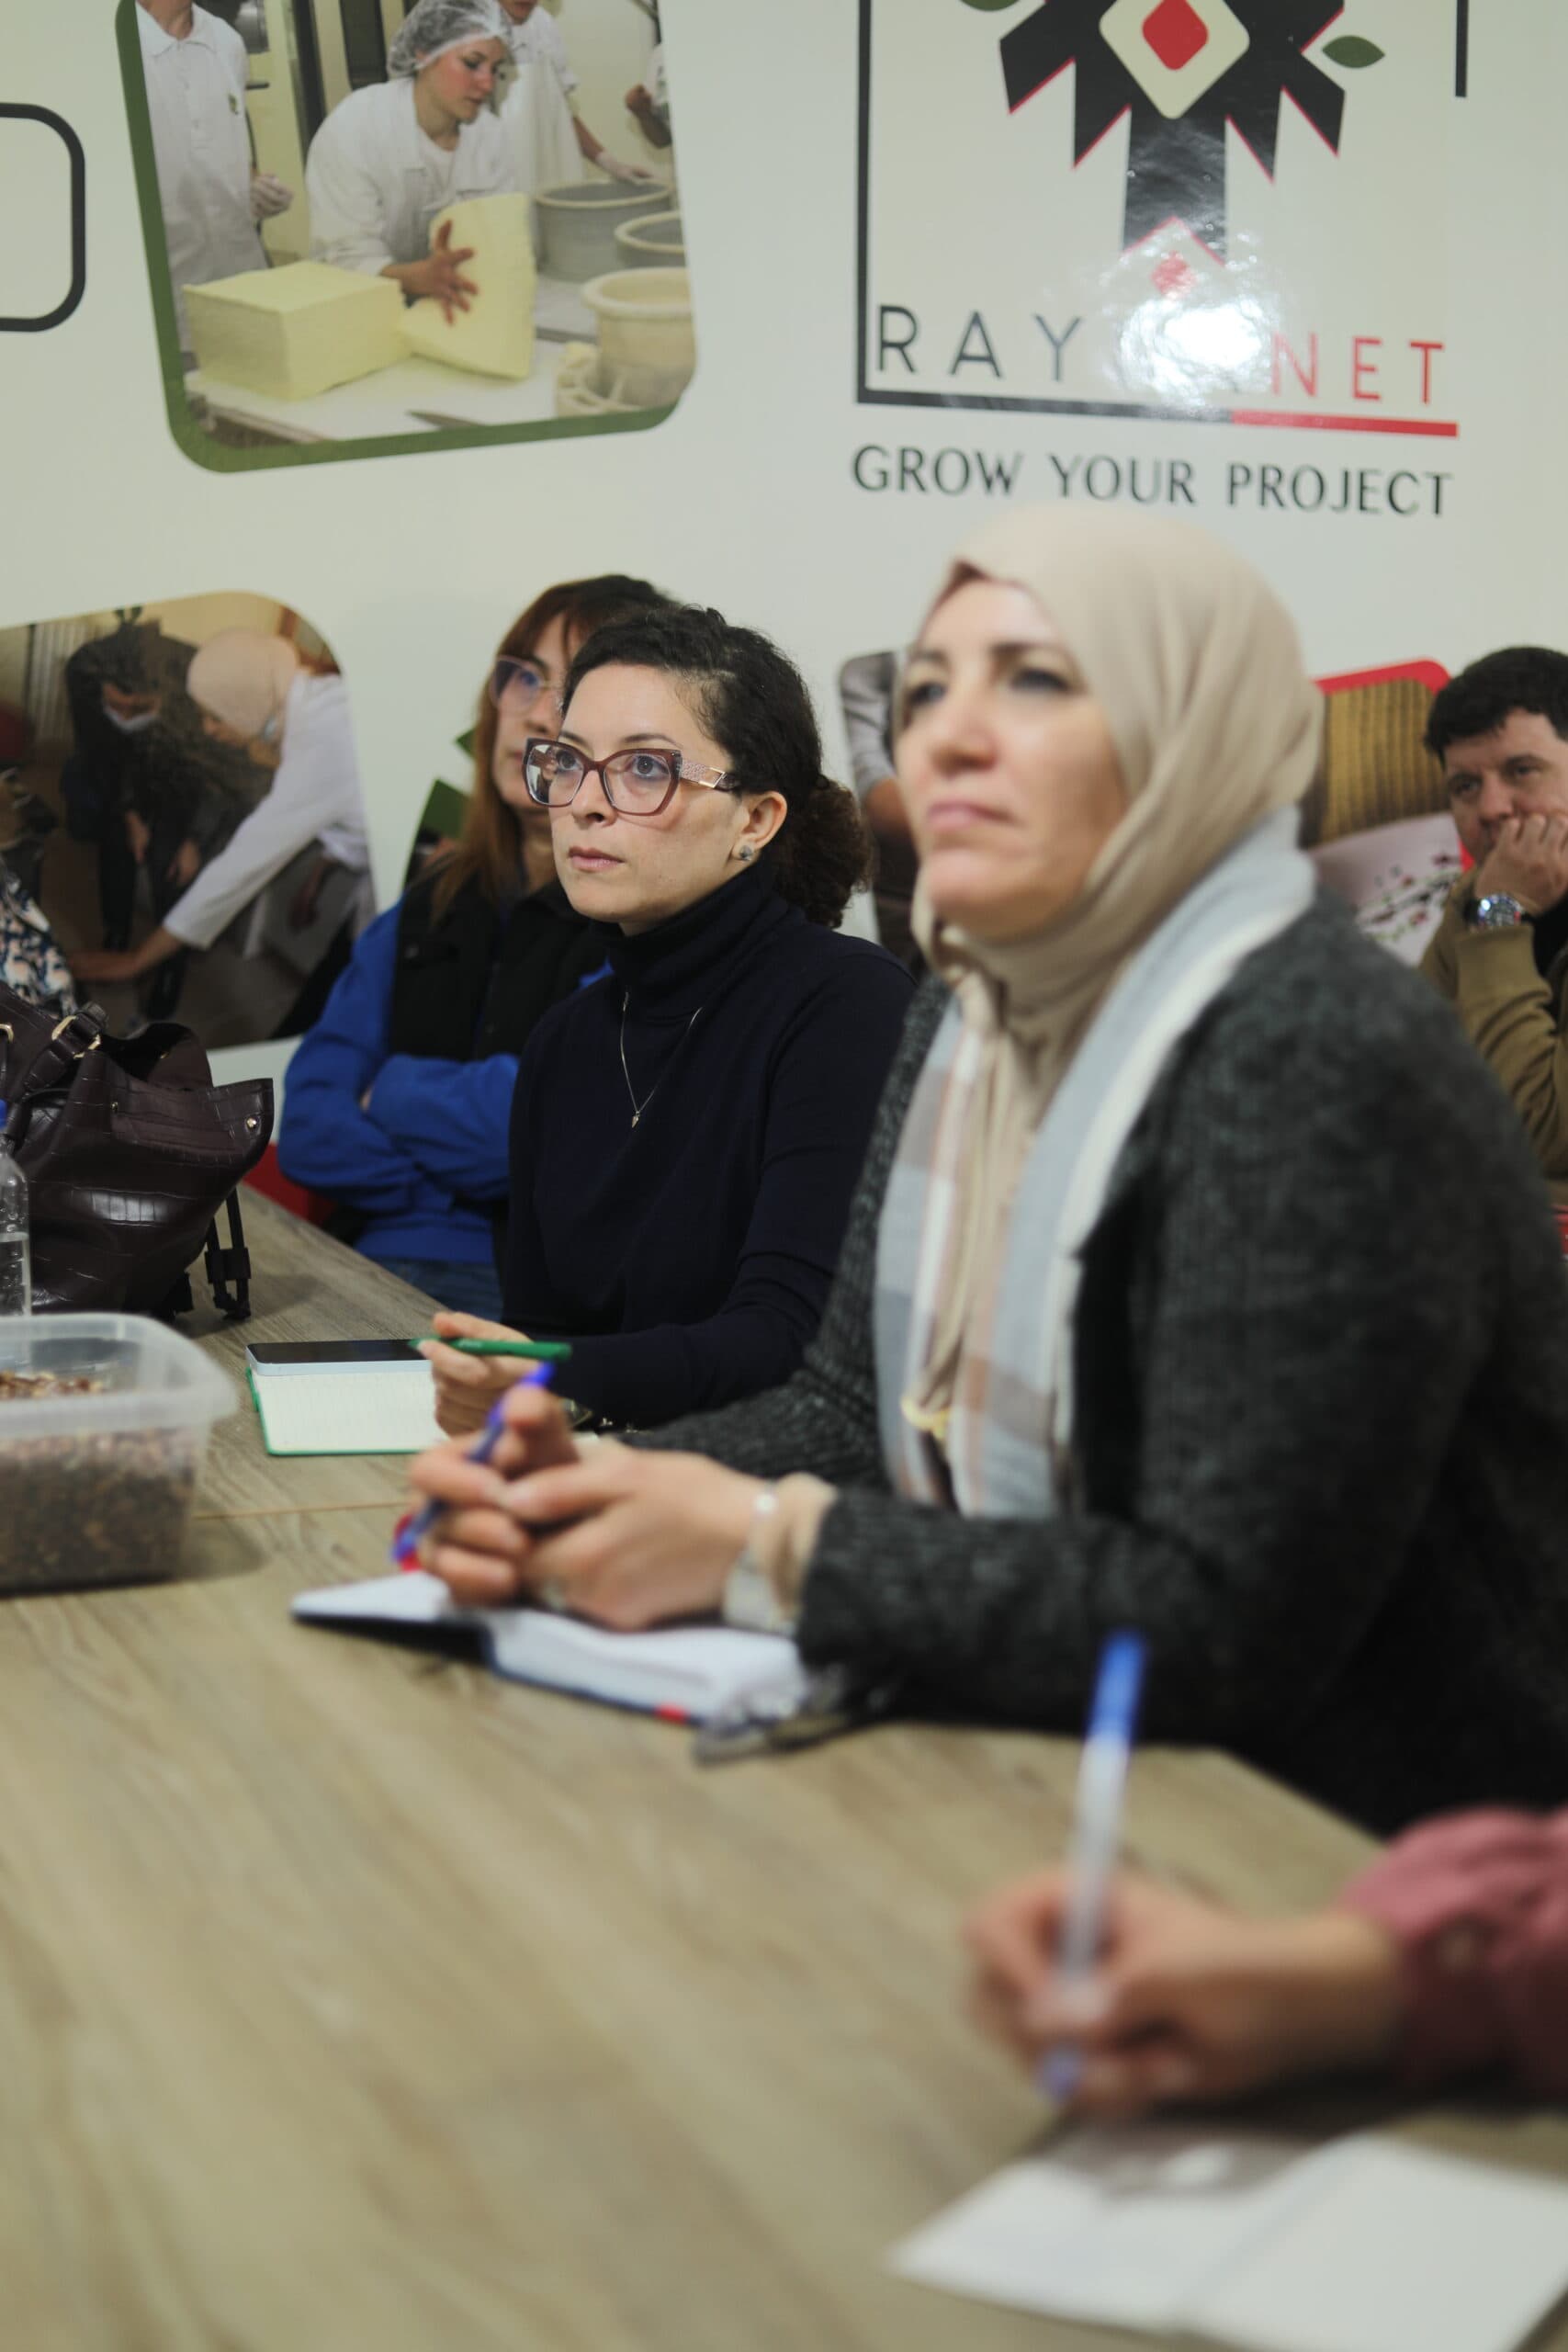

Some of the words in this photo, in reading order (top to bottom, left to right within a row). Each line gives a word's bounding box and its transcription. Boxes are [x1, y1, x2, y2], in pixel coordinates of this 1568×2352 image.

[878, 304, 1445, 405] RAYNET
[853, 444, 1024, 495] GROW
[1048, 453, 1196, 504] YOUR
[1226, 462, 1454, 516] PROJECT
